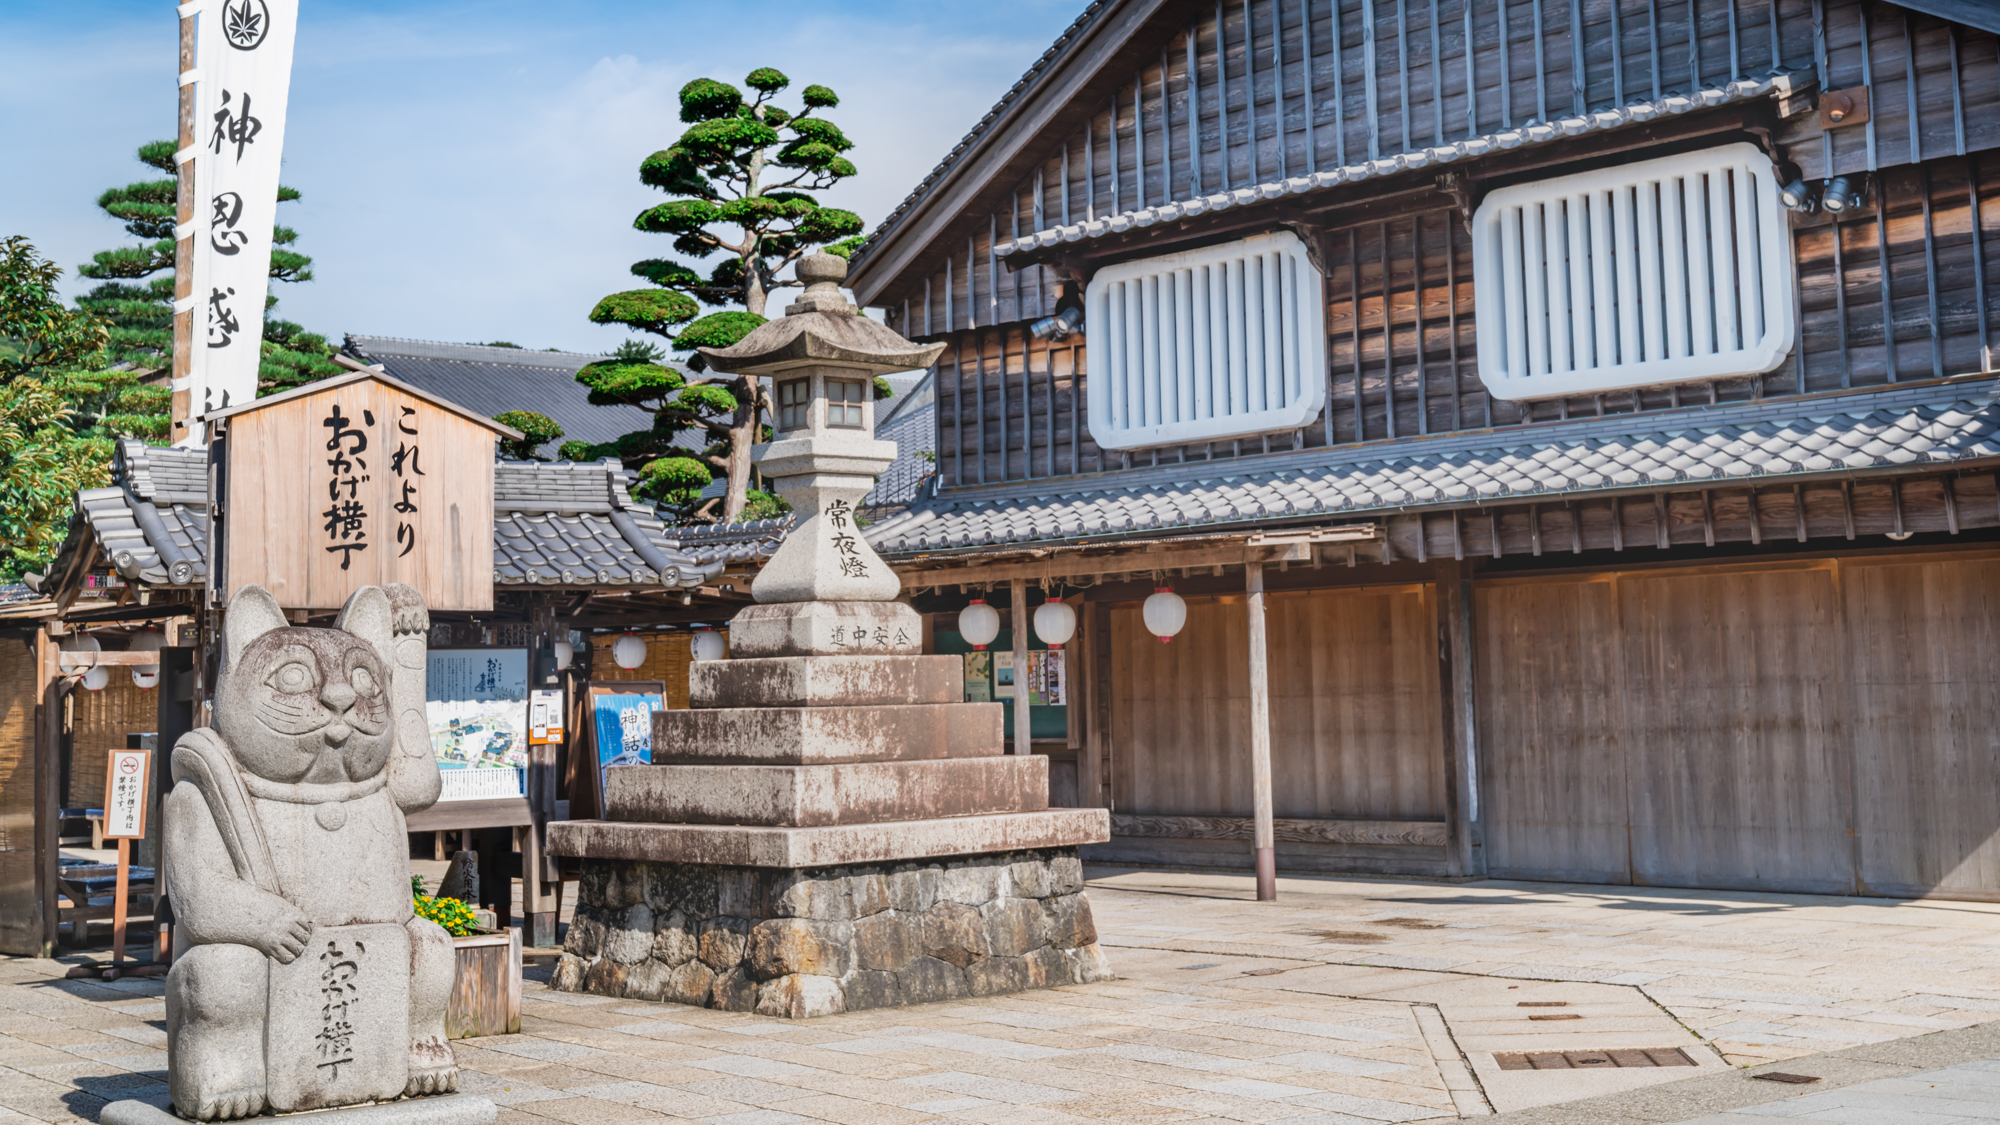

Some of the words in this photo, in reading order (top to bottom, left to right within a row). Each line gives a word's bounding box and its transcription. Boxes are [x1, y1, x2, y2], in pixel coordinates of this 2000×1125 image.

[323, 405, 375, 571] おかげ横丁
[391, 406, 426, 558] これより
[825, 499, 870, 578] 常夜燈
[830, 625, 910, 647] 道中安全
[117, 776, 126, 812] 禁煙です。
[126, 775, 137, 830] おかげ横丁内は
[315, 941, 366, 1083] おかげ横丁
